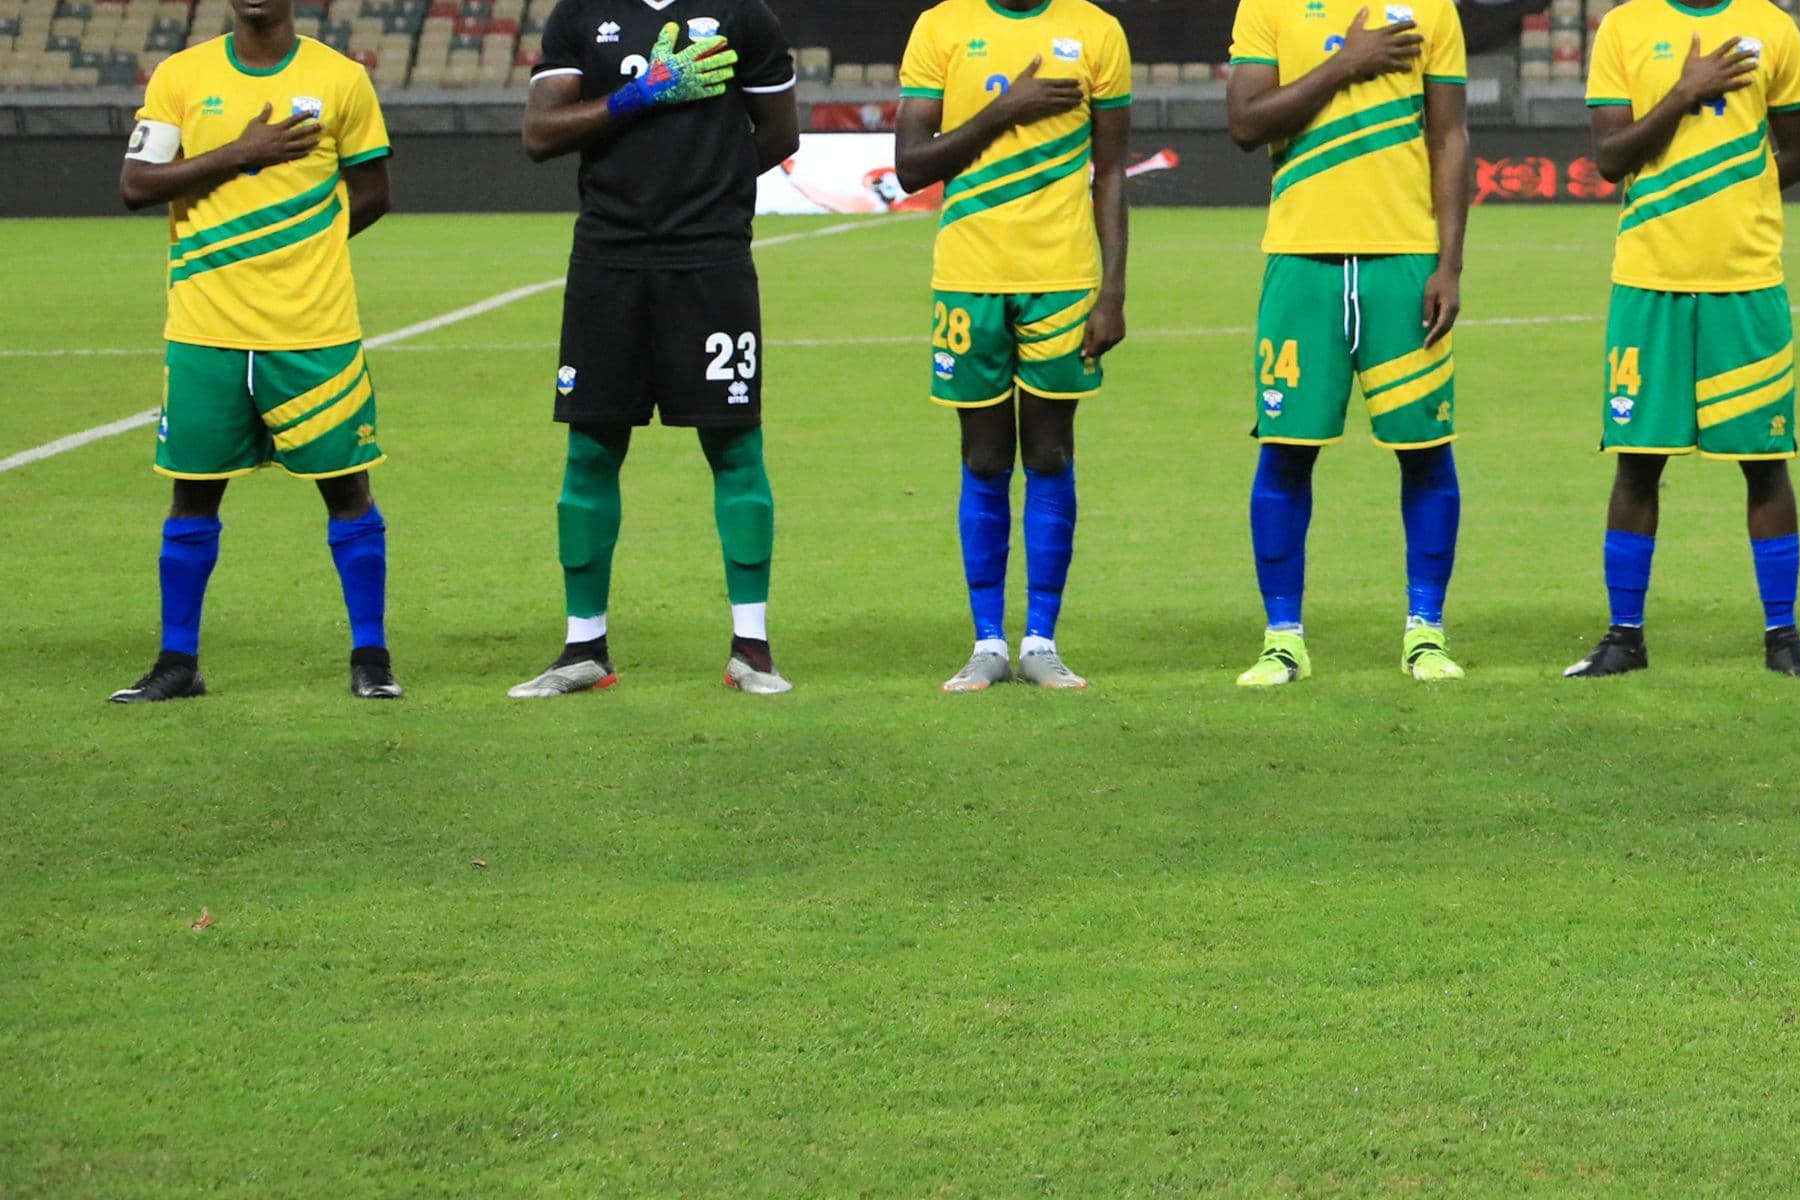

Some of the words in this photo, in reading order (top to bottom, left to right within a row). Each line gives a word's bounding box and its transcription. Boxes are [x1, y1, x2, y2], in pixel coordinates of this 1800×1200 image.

[932, 300, 972, 355] 28
[705, 331, 756, 380] 23
[1259, 338, 1300, 388] 24
[1608, 346, 1642, 395] 14
